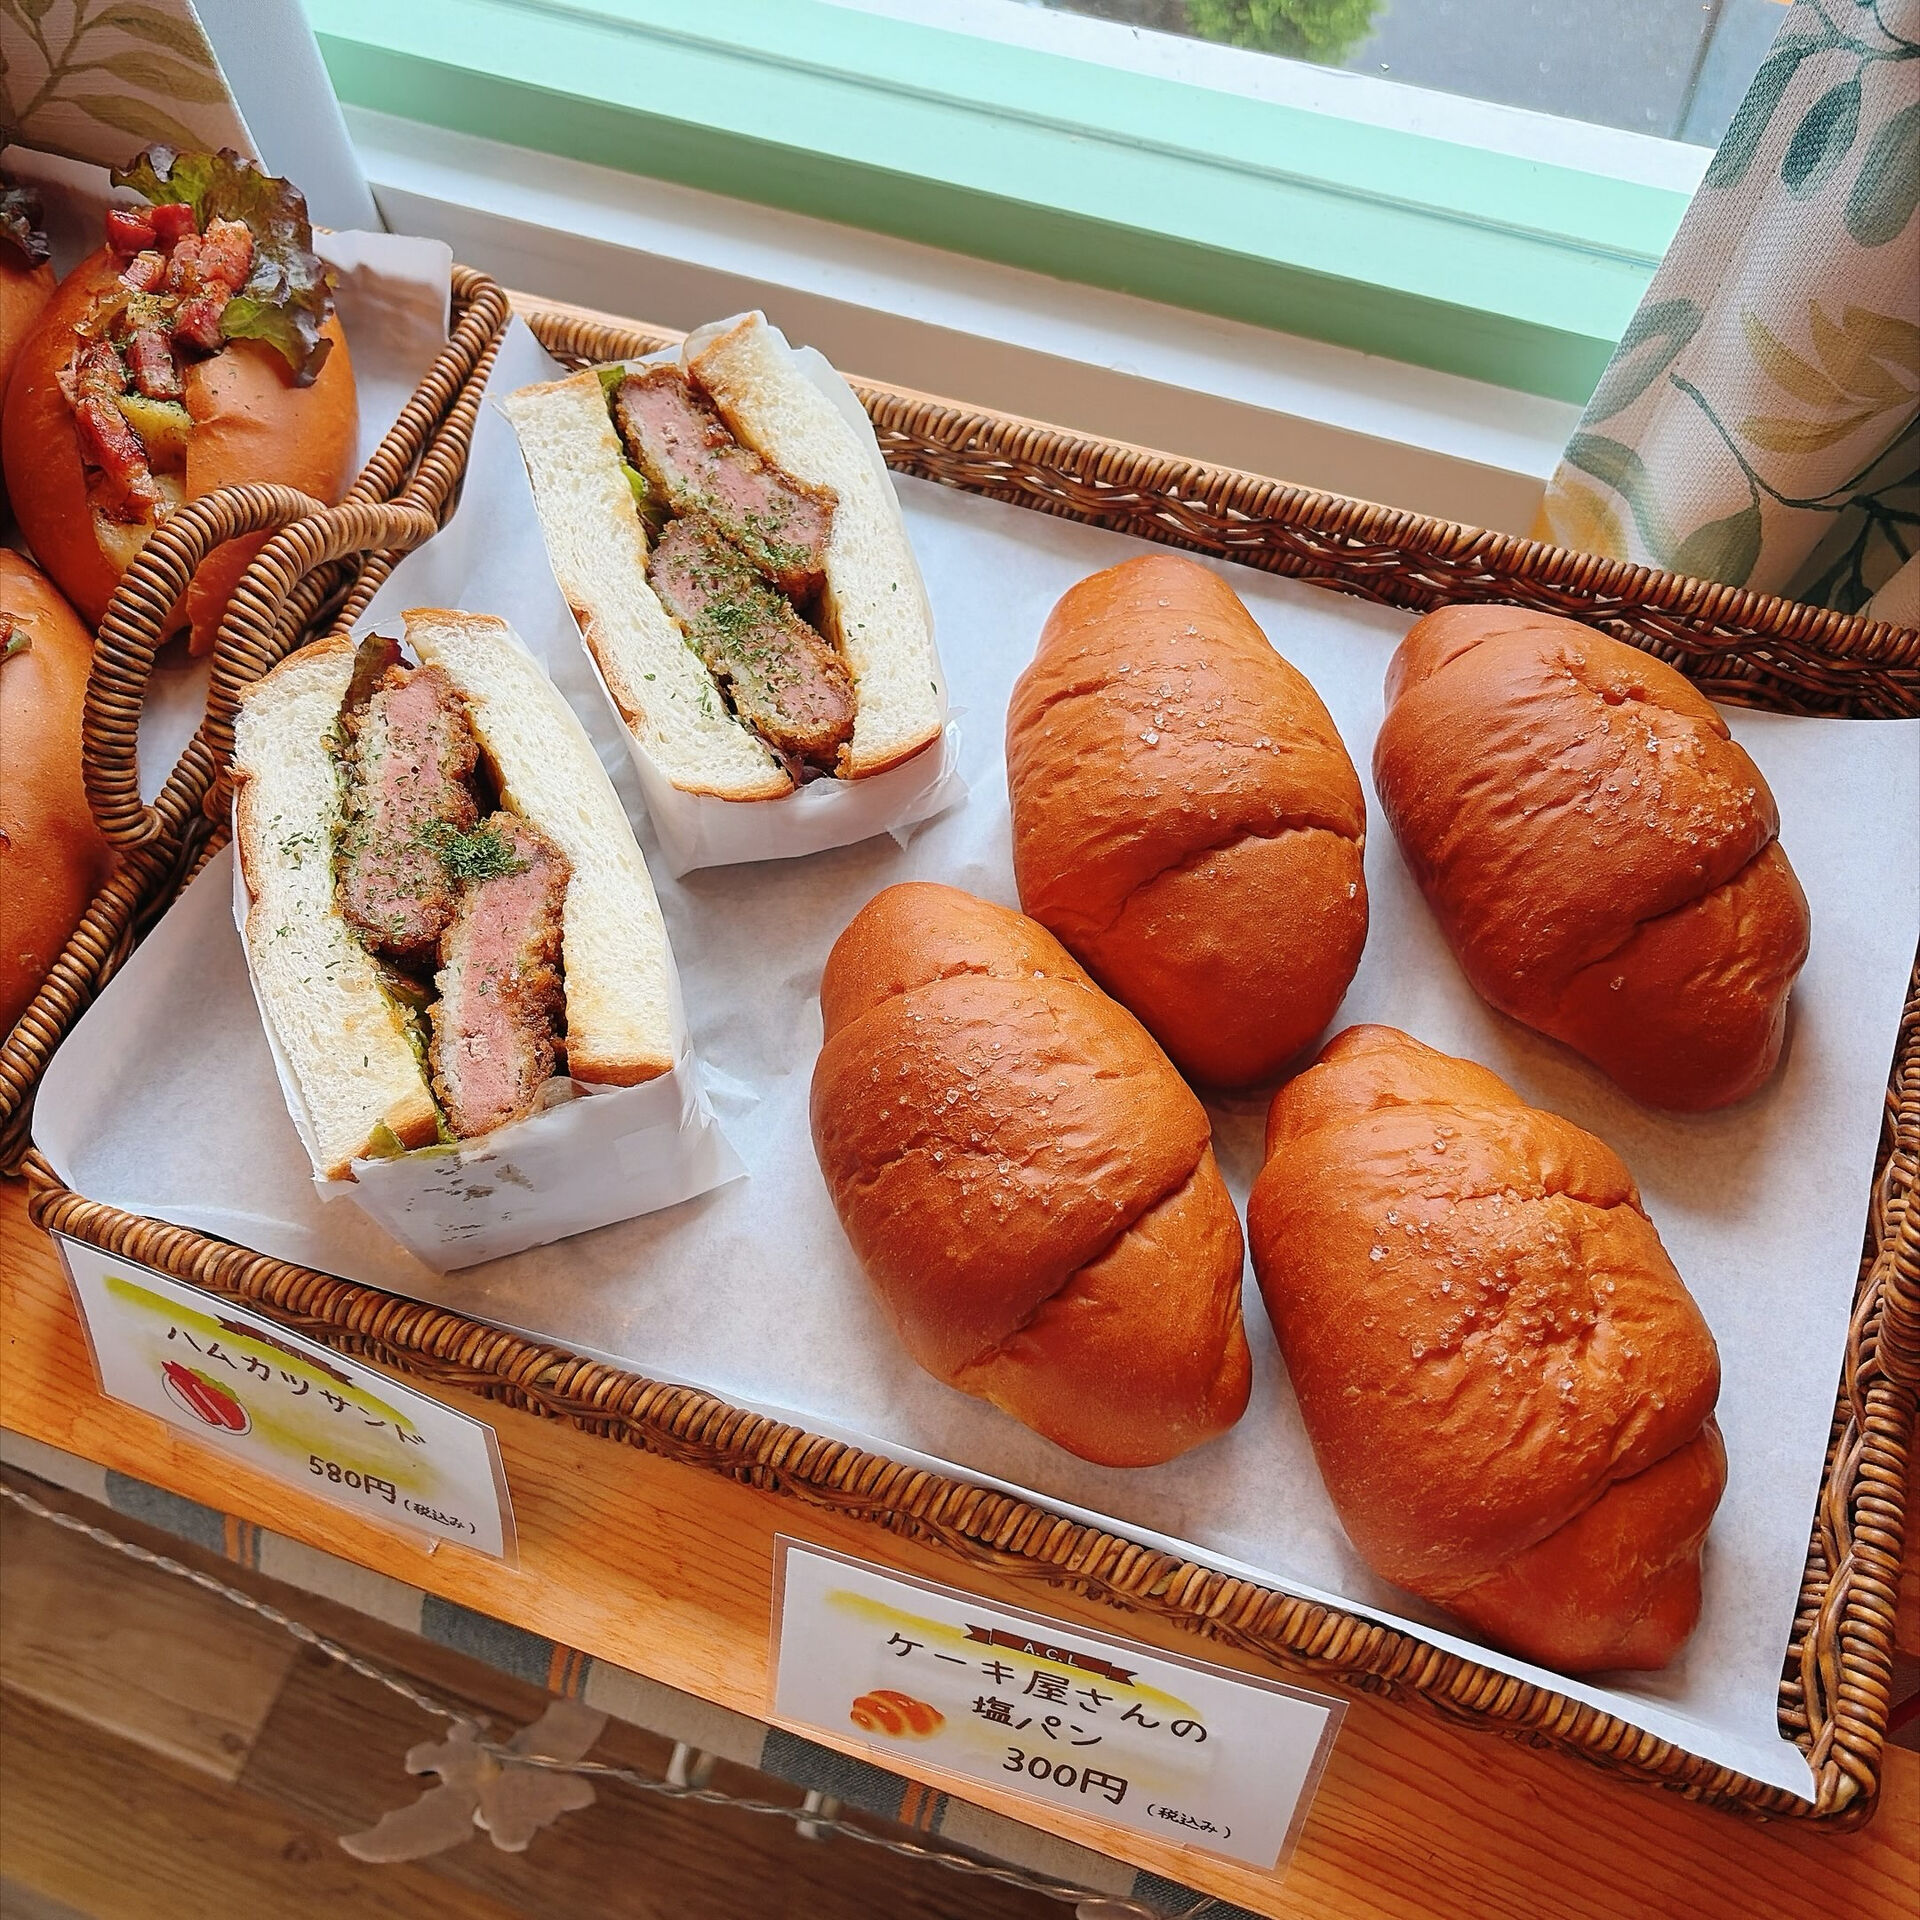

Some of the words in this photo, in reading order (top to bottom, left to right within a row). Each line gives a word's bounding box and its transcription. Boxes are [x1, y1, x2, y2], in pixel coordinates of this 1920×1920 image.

[167, 1326, 426, 1444] ハムカツサンド
[309, 1455, 397, 1504] 580円
[887, 1632, 1208, 1743] ケーキ屋さんの
[972, 1696, 1103, 1746] 塩パン
[1002, 1747, 1128, 1805] 300円
